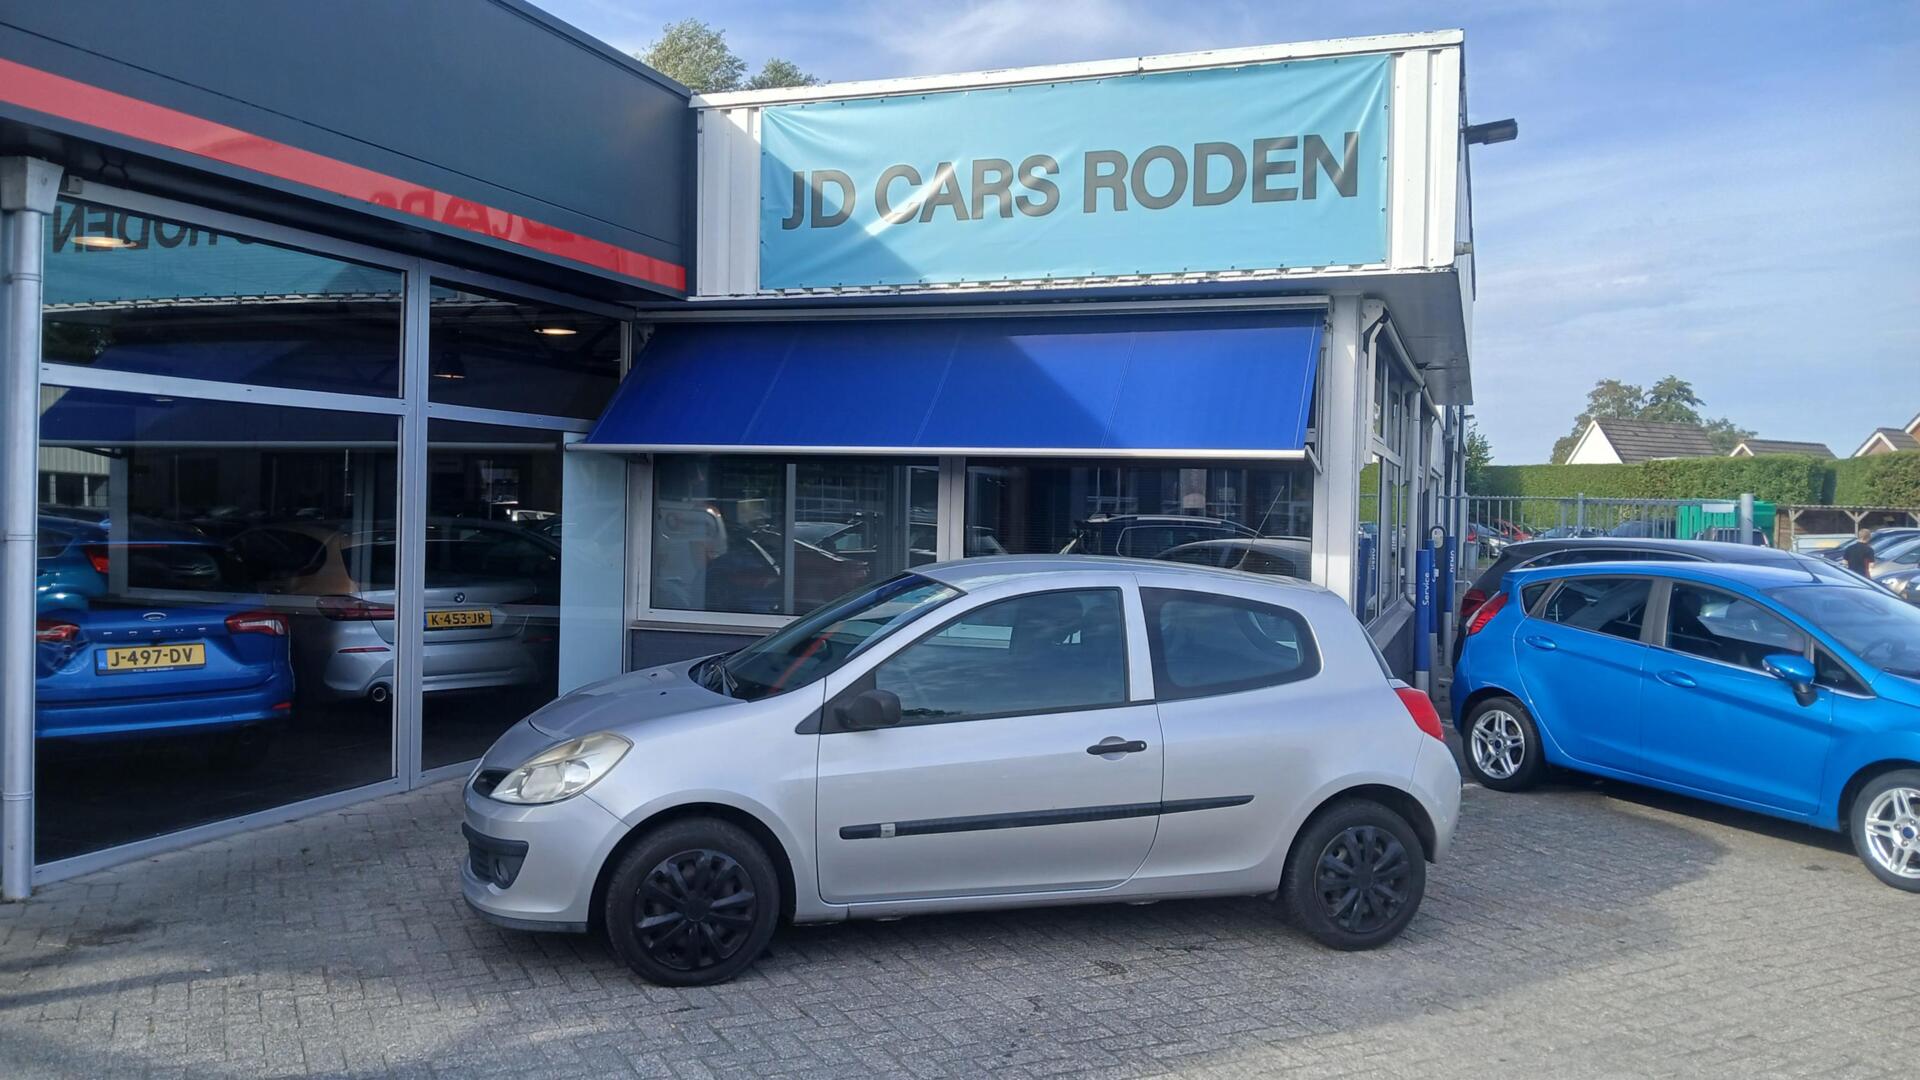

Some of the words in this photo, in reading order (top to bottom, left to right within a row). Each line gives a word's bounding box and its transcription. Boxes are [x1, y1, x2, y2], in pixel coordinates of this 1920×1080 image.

[781, 168, 856, 230] JD
[874, 153, 1060, 225] CARS
[1082, 130, 1360, 214] RODEN
[1422, 572, 1430, 607] Service
[431, 613, 485, 625] K-453-JR
[111, 647, 193, 667] J-497-DV
